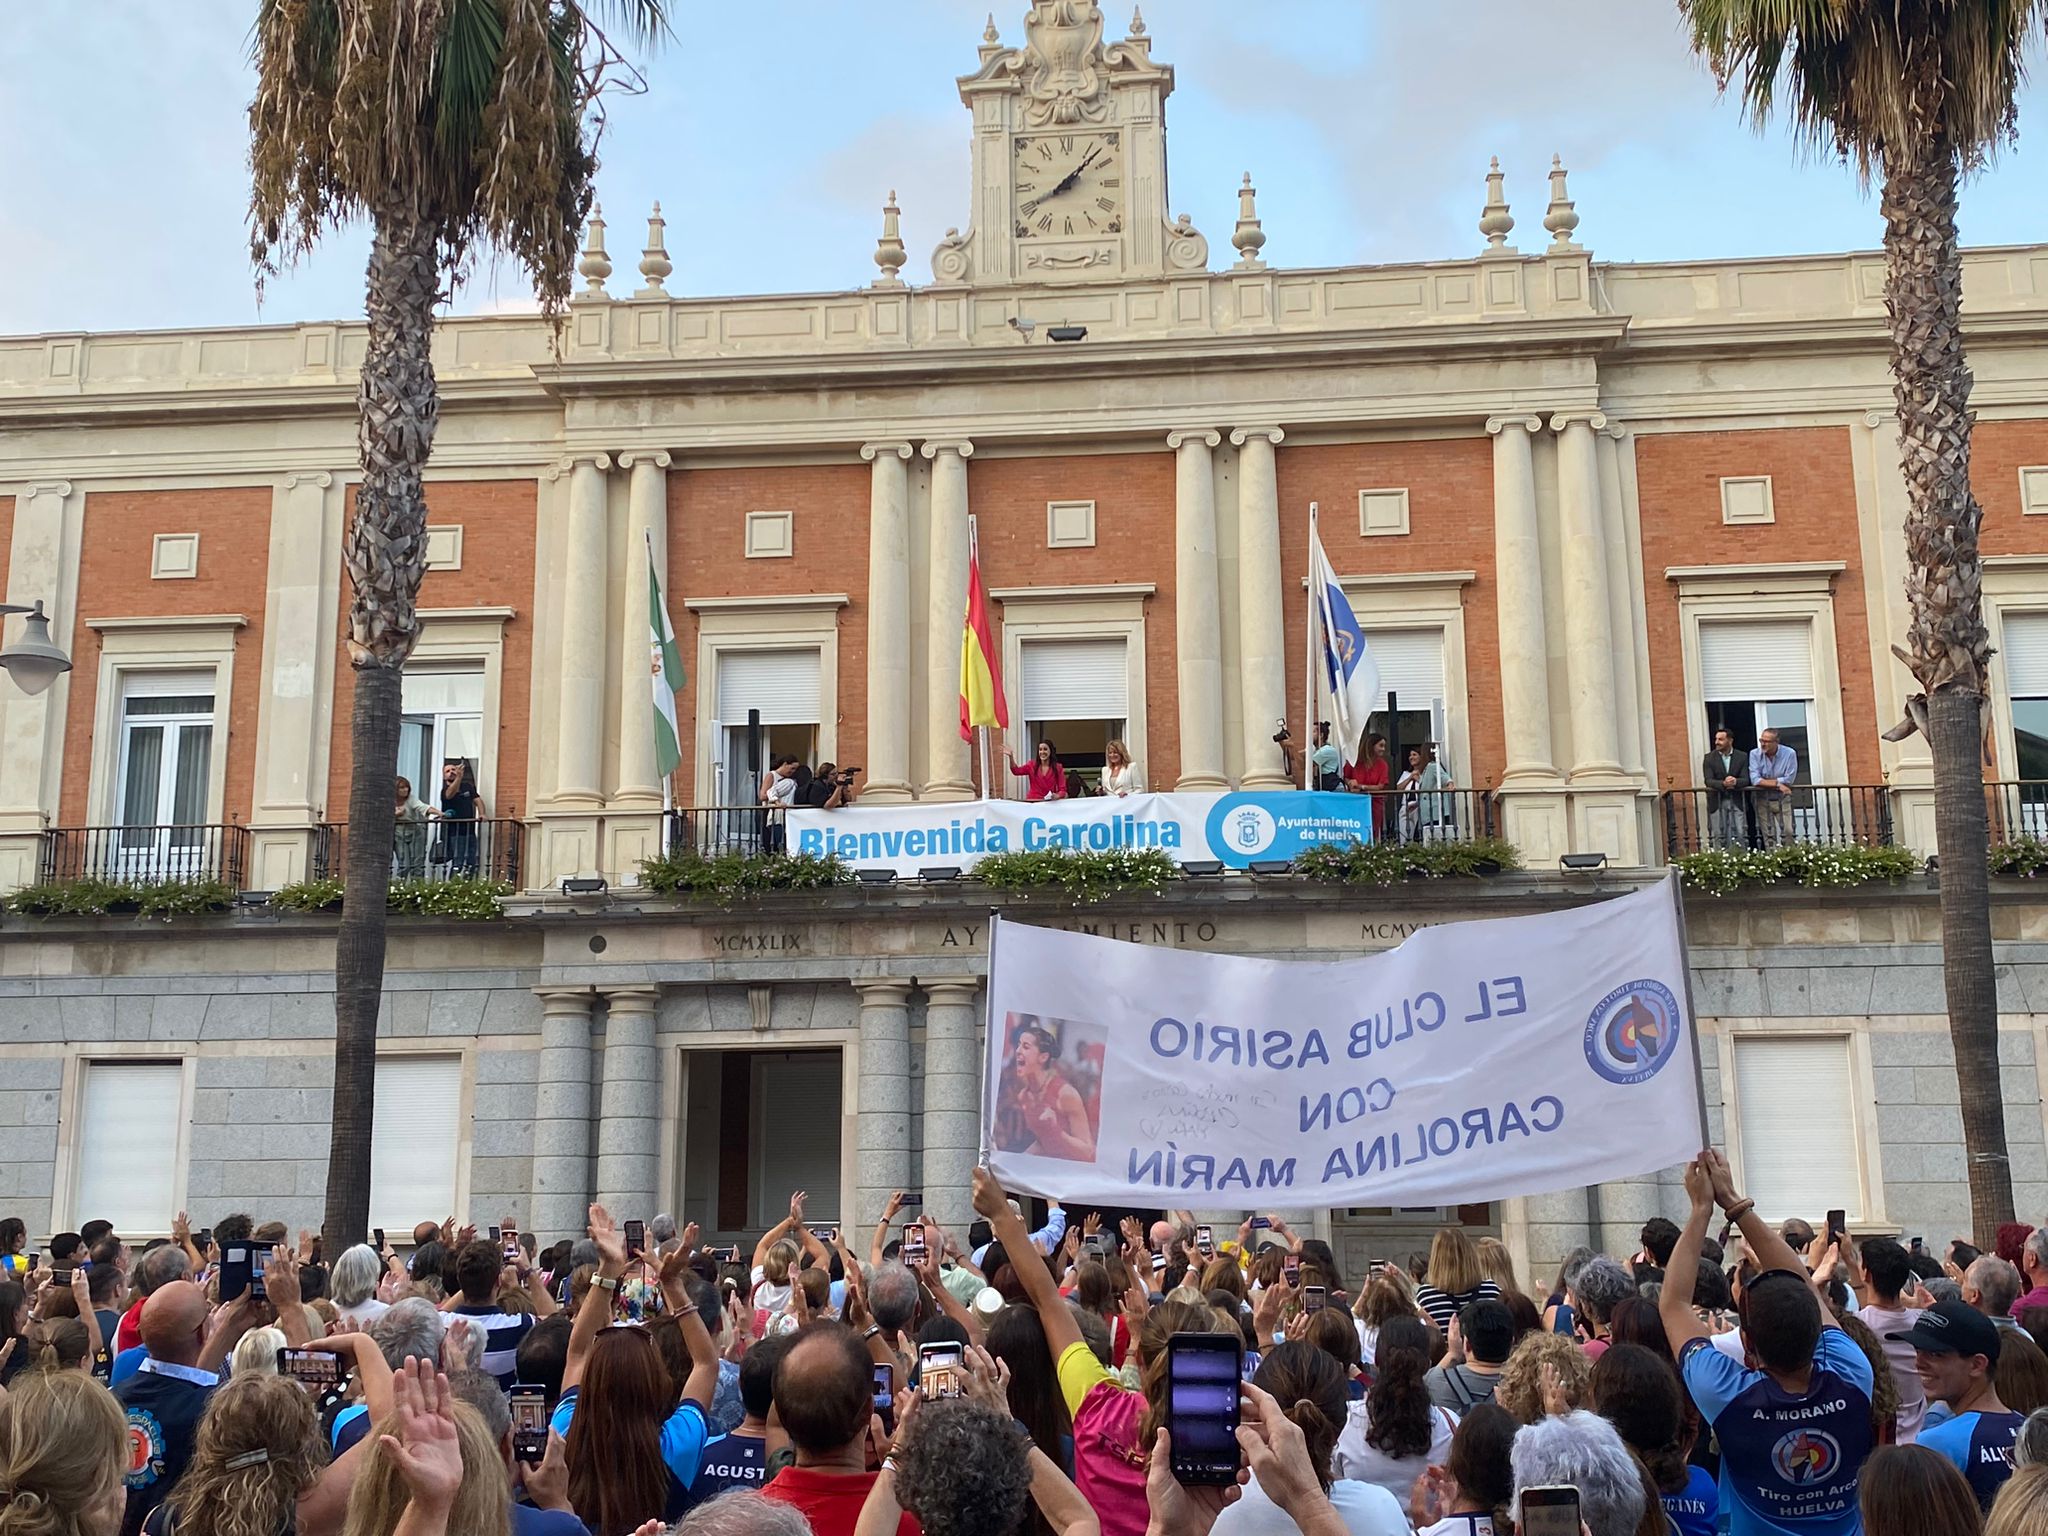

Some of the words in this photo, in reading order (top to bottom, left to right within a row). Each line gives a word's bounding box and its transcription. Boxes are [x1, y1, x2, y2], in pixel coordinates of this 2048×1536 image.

[1278, 816, 1361, 830] Ayuntamiento
[800, 818, 1009, 860] Bienvenida
[1023, 814, 1181, 850] Carolina
[1299, 828, 1315, 841] de
[1318, 828, 1362, 842] Huelva
[714, 934, 801, 951] MCMXLIX
[1752, 1408, 1770, 1420] A.
[1775, 1399, 1847, 1421] MORANO
[127, 1413, 161, 1455] ESPACLUB
[1980, 1444, 2007, 1464] ÁLV
[704, 1463, 766, 1480] AGUST
[1757, 1486, 1791, 1501] Tiro
[1796, 1489, 1824, 1501] con
[1828, 1478, 1858, 1497] Arco
[1779, 1500, 1846, 1516] HUELVA
